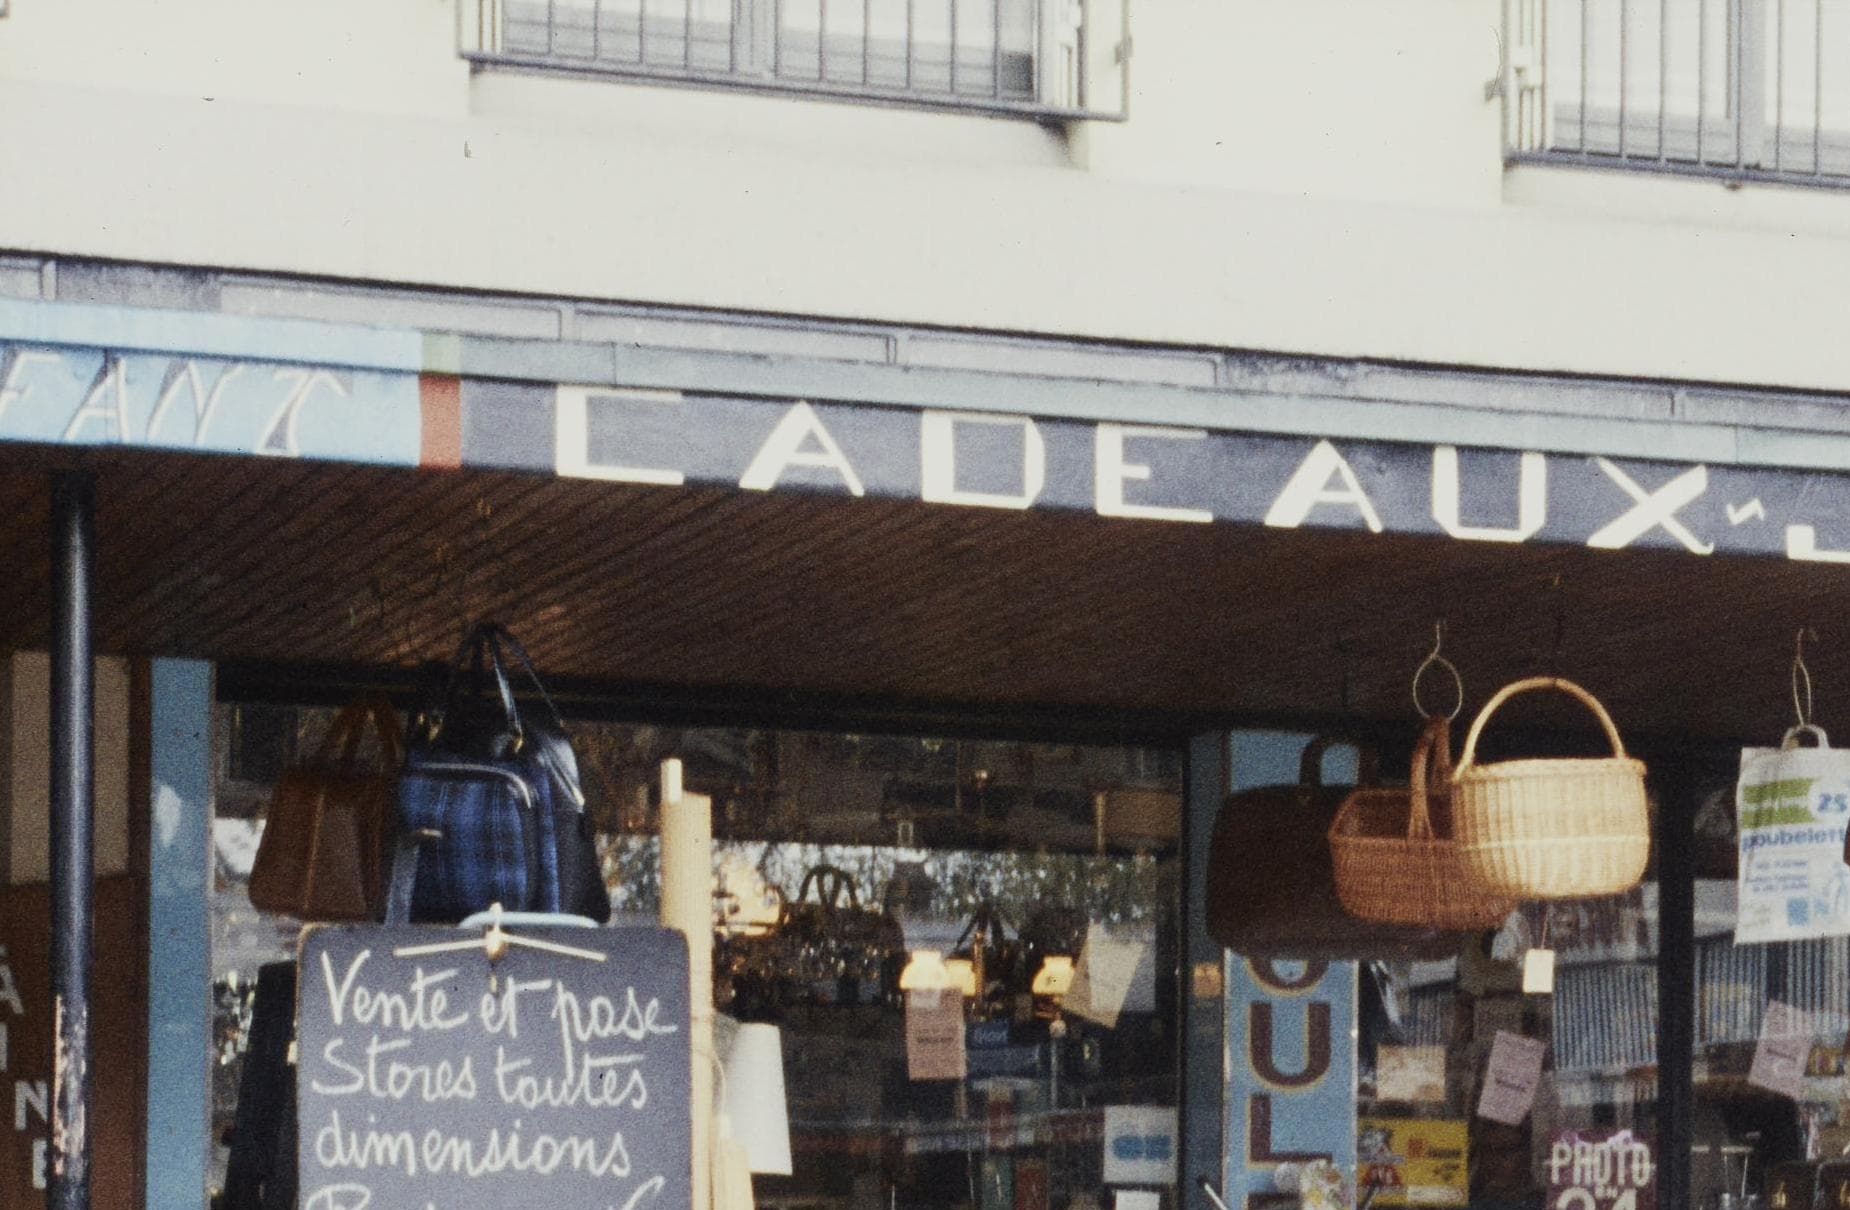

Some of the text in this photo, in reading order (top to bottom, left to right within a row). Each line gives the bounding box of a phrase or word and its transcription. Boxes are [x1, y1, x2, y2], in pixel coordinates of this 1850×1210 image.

[320, 948, 678, 1086] Vente et pose
[311, 1034, 649, 1109] Stores toutes
[315, 1109, 632, 1177] dimensions
[1551, 1140, 1651, 1187] PHOTO
